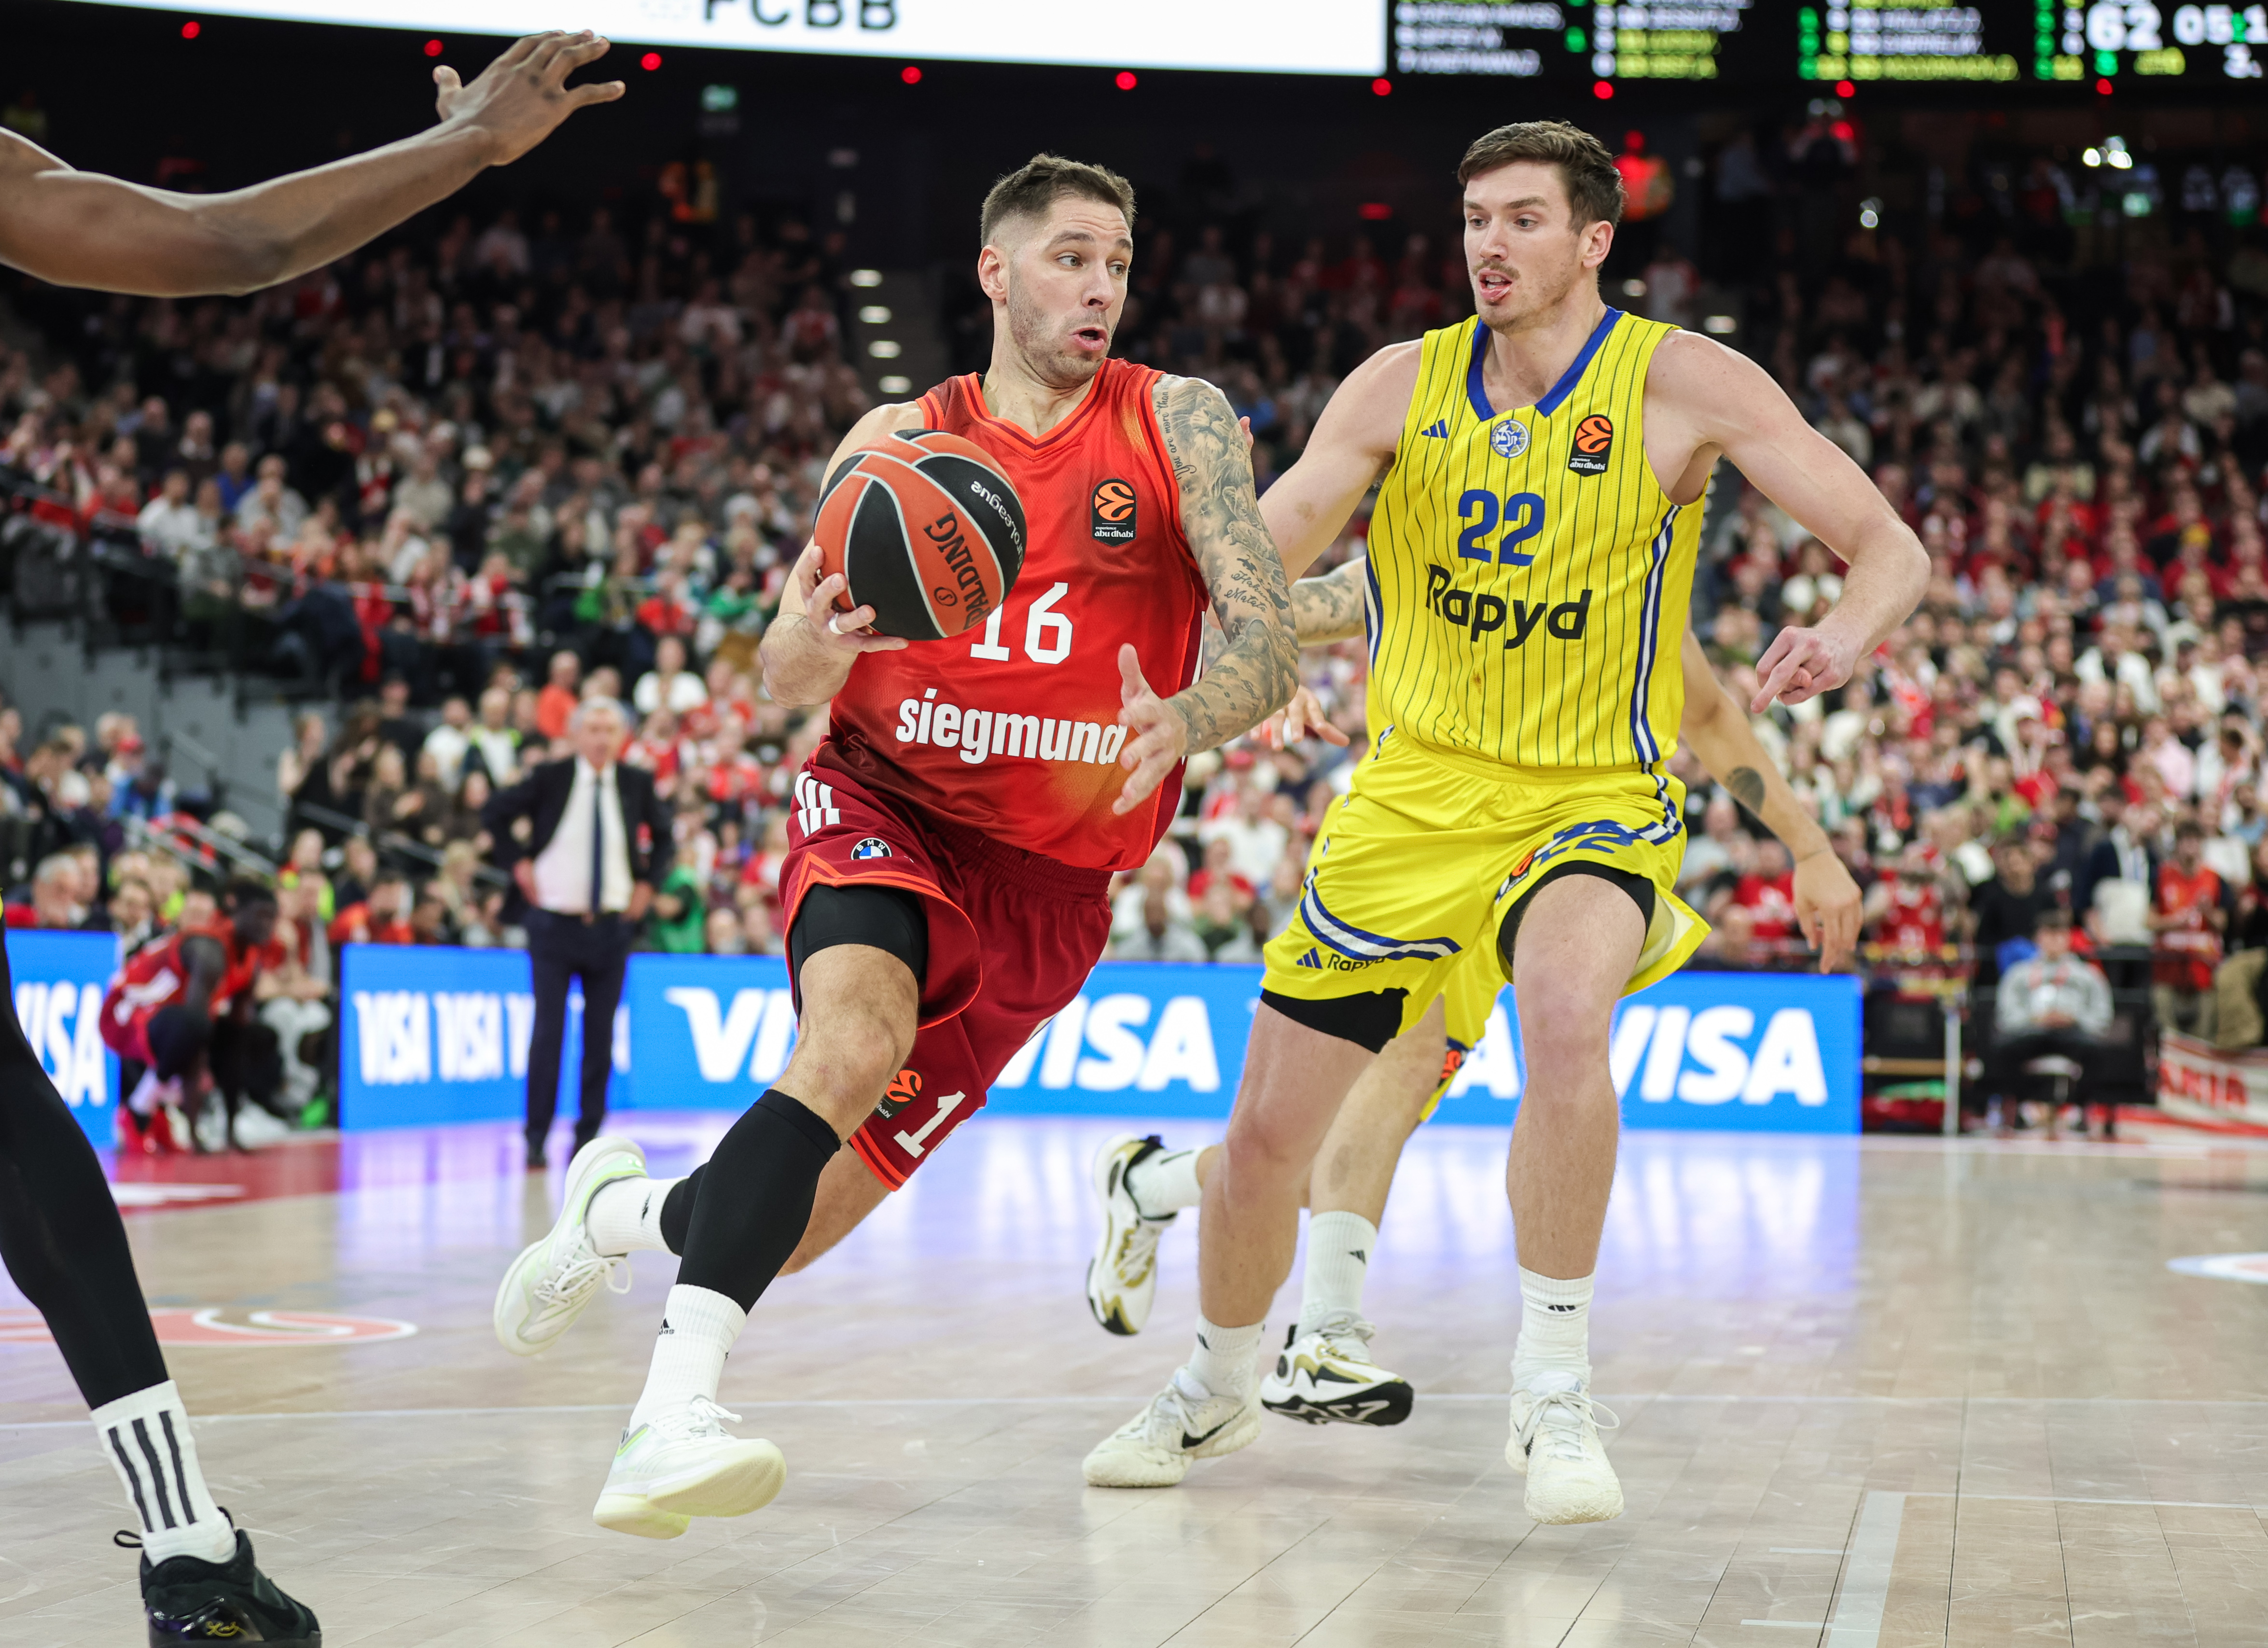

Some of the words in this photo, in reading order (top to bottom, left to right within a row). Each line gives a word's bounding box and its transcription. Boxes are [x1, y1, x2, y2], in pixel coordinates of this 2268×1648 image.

[2086, 1, 2163, 51] 62
[1584, 462, 1606, 471] dhabi
[1458, 489, 1545, 567] 22
[923, 512, 991, 630] PALDING
[1426, 564, 1593, 649] Rapyd
[970, 582, 1073, 665] 16
[856, 840, 886, 852] BMW
[352, 991, 431, 1085] VISA
[433, 991, 504, 1082] VISA
[665, 988, 797, 1082] VI
[876, 1103, 892, 1118] habi
[893, 1090, 971, 1161] 1
